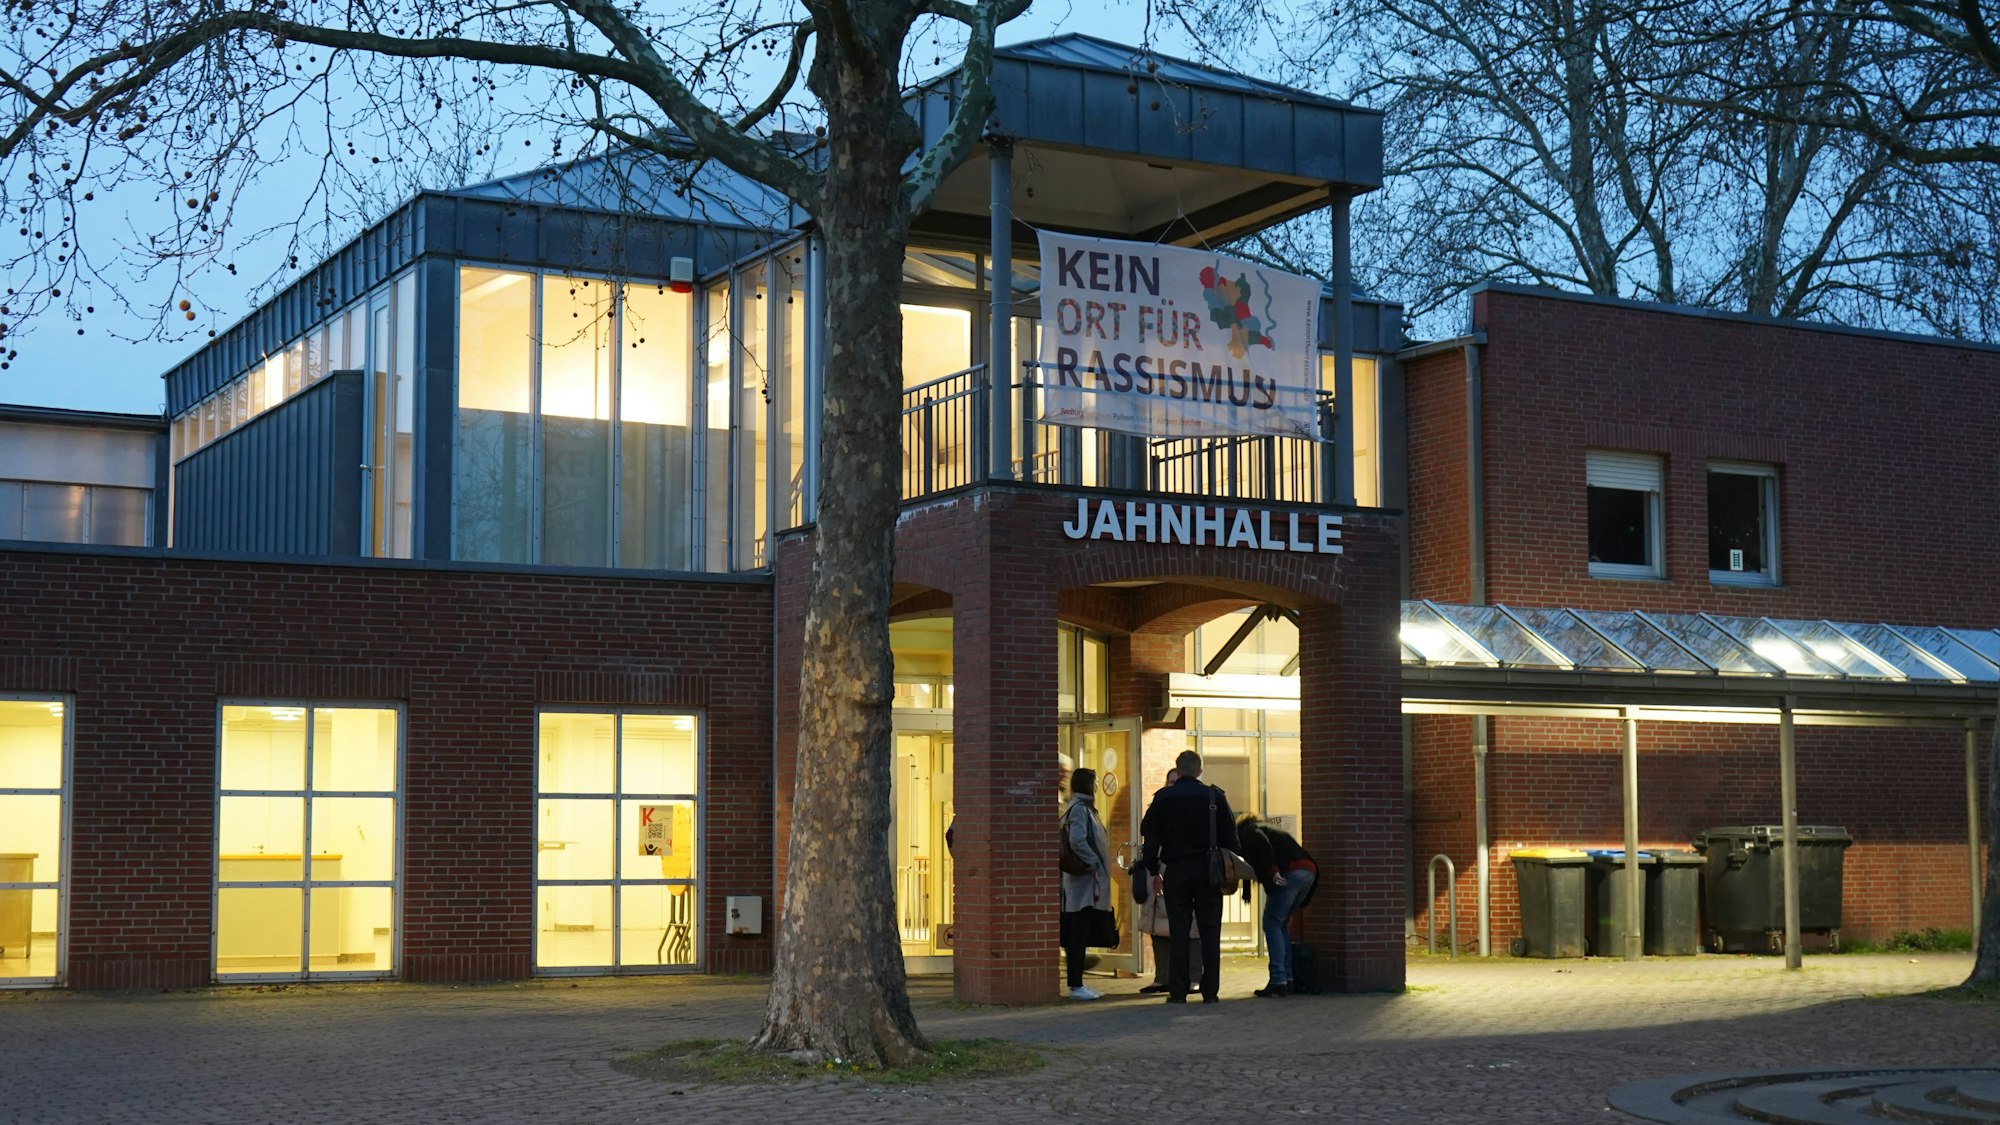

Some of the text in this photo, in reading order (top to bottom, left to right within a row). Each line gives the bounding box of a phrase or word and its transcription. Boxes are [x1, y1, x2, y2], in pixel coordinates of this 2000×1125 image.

[1057, 247, 1159, 296] KEIN
[1057, 298, 1203, 351] ORT FÜR
[1057, 346, 1276, 410] RASSISMUS
[1063, 498, 1344, 554] JAHNHALLE
